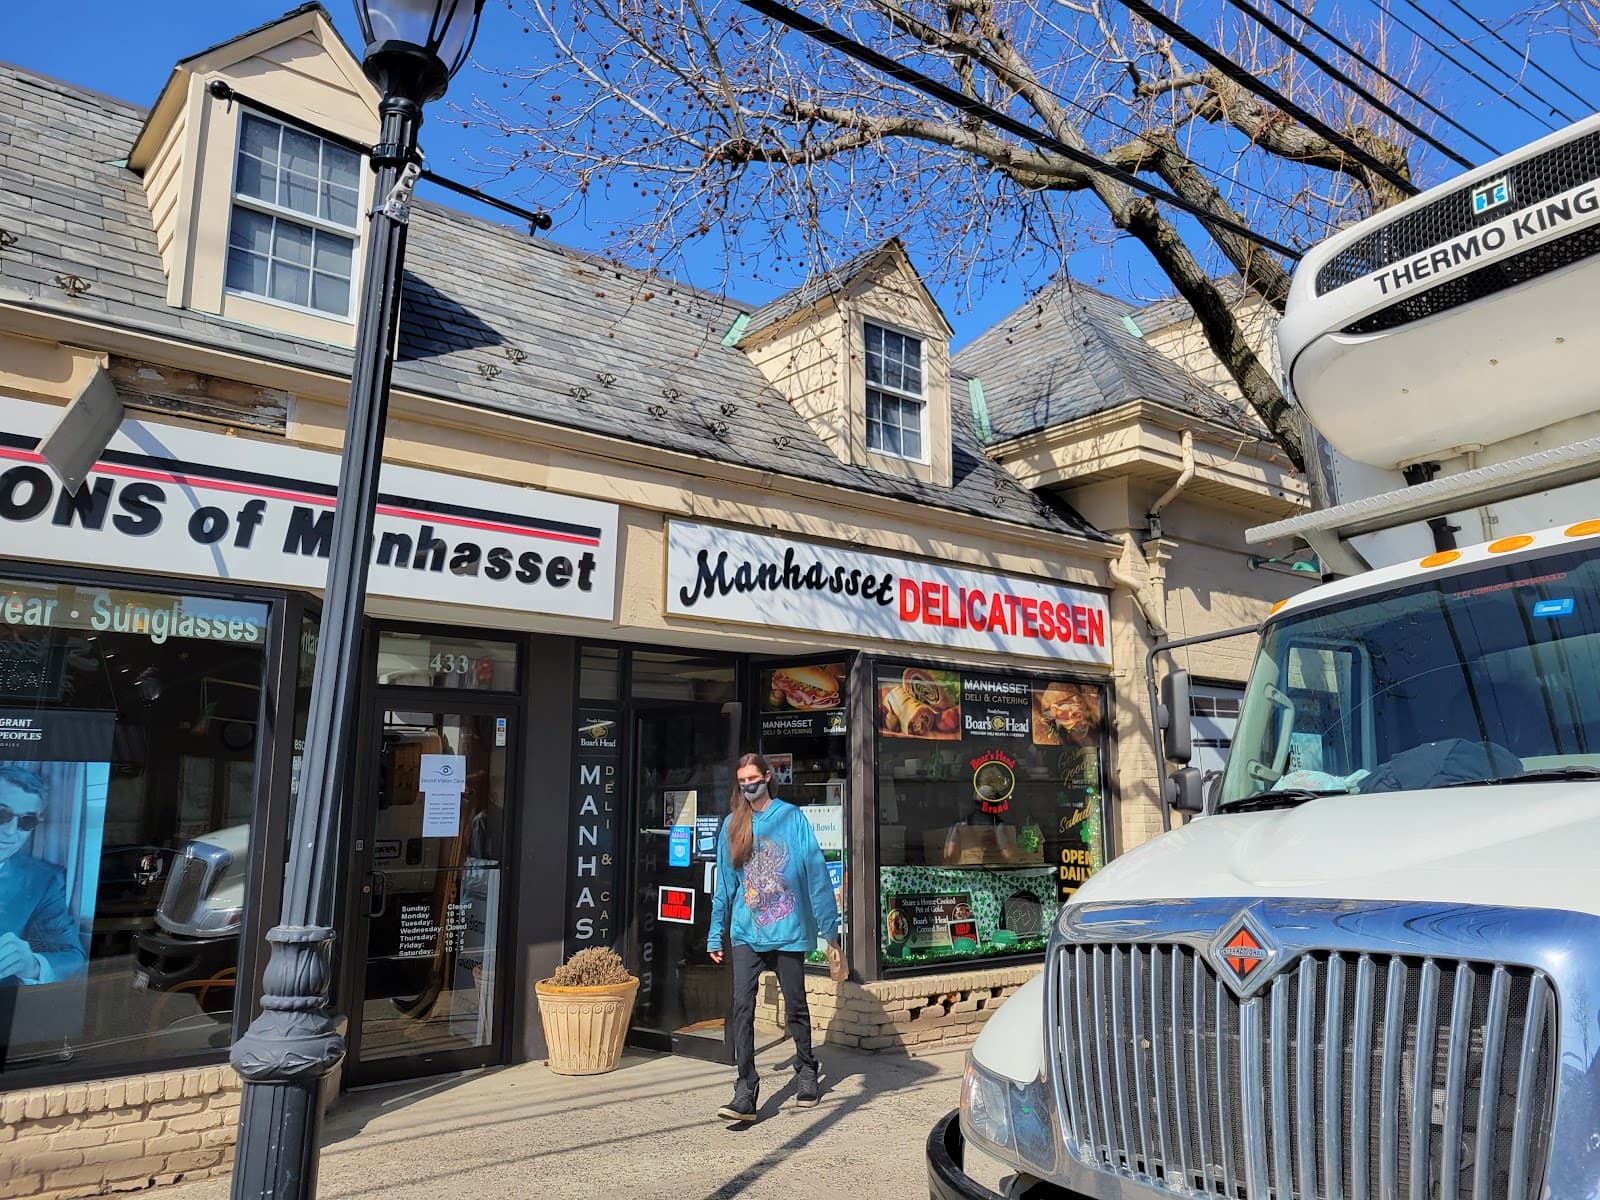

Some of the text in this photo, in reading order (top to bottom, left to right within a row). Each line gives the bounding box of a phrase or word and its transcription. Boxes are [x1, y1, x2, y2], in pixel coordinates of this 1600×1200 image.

[1373, 186, 1600, 296] THERMO KING
[187, 499, 265, 550] of
[283, 503, 597, 593] Mnhasset
[680, 546, 1105, 648] Manhasset DELICATESSEN
[0, 594, 259, 645] ear Sunglasses
[430, 653, 469, 674] 433
[964, 679, 1029, 695] MANHASSET
[965, 693, 1029, 706] DELI & CATERING
[0, 718, 33, 727] GRANT
[762, 719, 814, 729] MANHASSET
[965, 714, 1029, 733] Boar's Head
[599, 738, 617, 748] Head
[981, 801, 1009, 815] Brand
[816, 822, 836, 832] Bowls
[601, 853, 612, 866] &
[1061, 848, 1093, 866] OPEN
[1060, 865, 1094, 882] DAILY
[401, 905, 430, 913] Sunday:
[955, 923, 971, 934] HELP
[400, 933, 437, 942] Thursday:
[398, 948, 434, 957] Saturday:
[399, 942, 424, 950] Friday:
